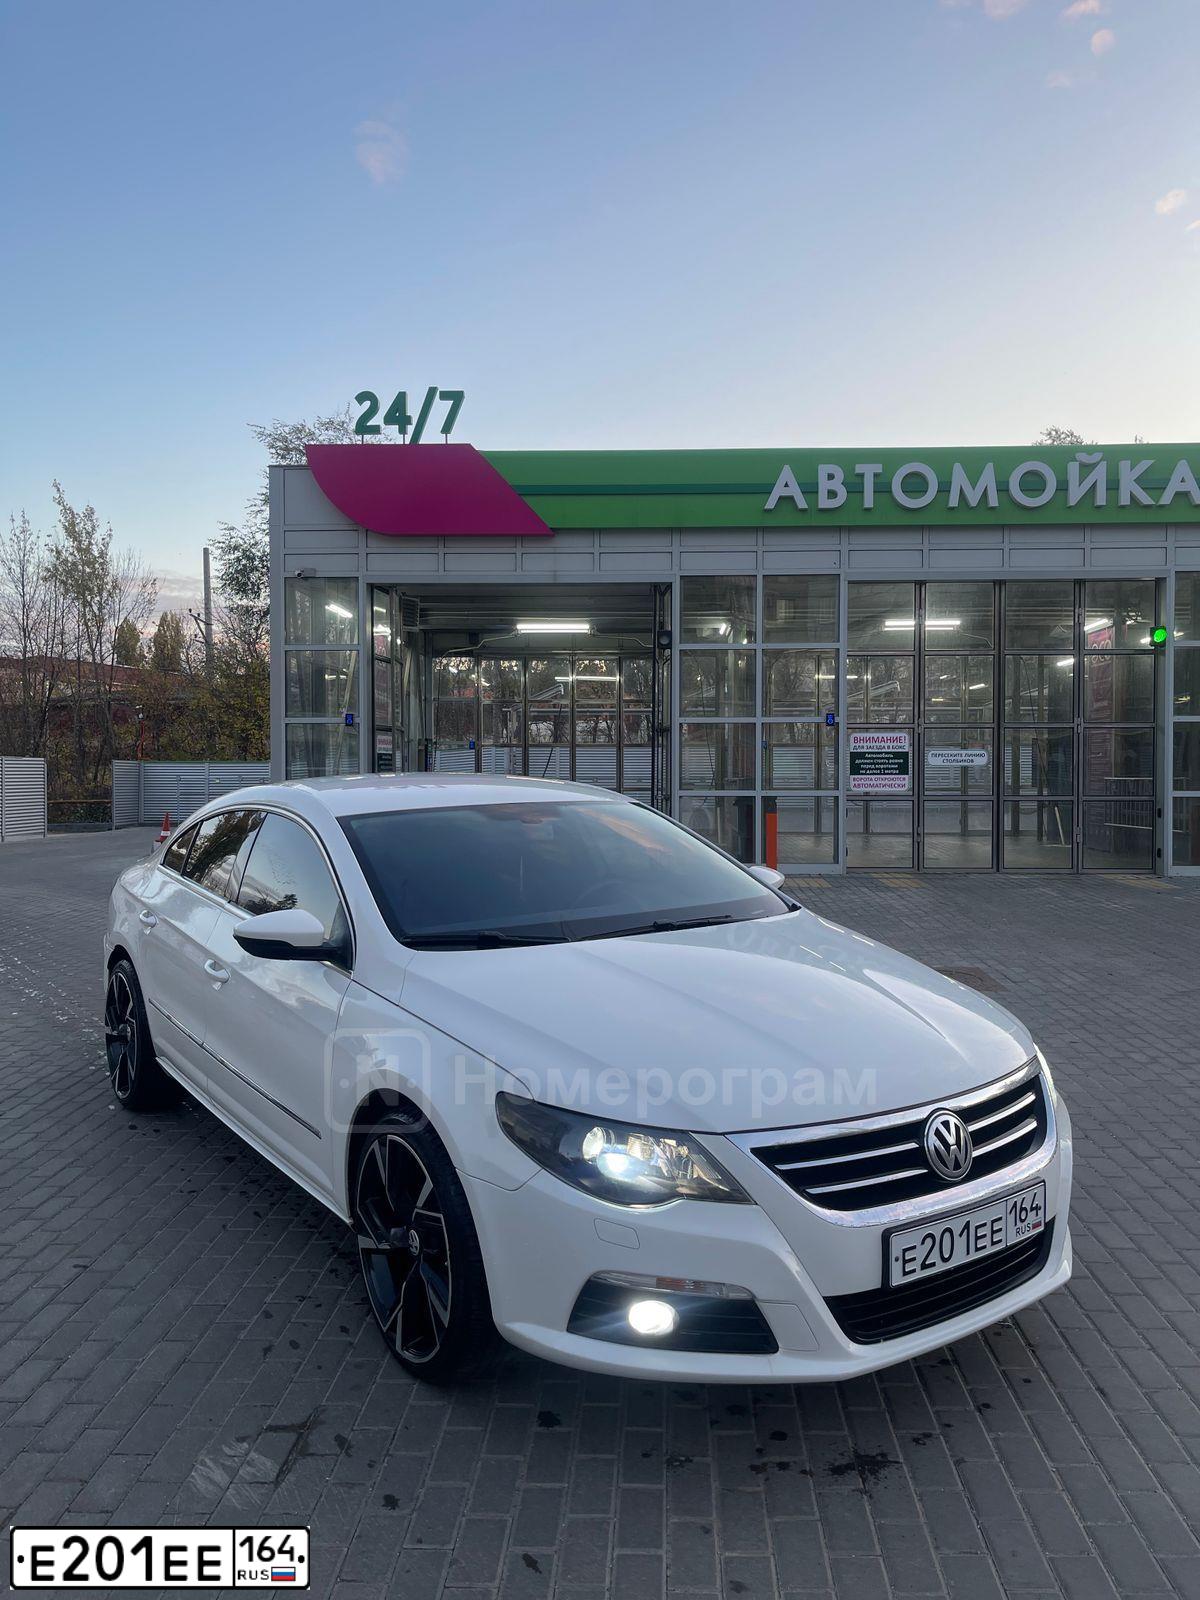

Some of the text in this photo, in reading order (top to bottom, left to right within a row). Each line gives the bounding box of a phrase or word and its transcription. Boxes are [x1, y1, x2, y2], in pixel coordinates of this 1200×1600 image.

[354, 386, 465, 444] 24/7
[764, 452, 1200, 510] АВТОМОЙКА
[853, 736, 906, 744] ВНИМАНИЕ!
[1009, 1192, 1040, 1227] 164
[1016, 1223, 1032, 1238] RUS
